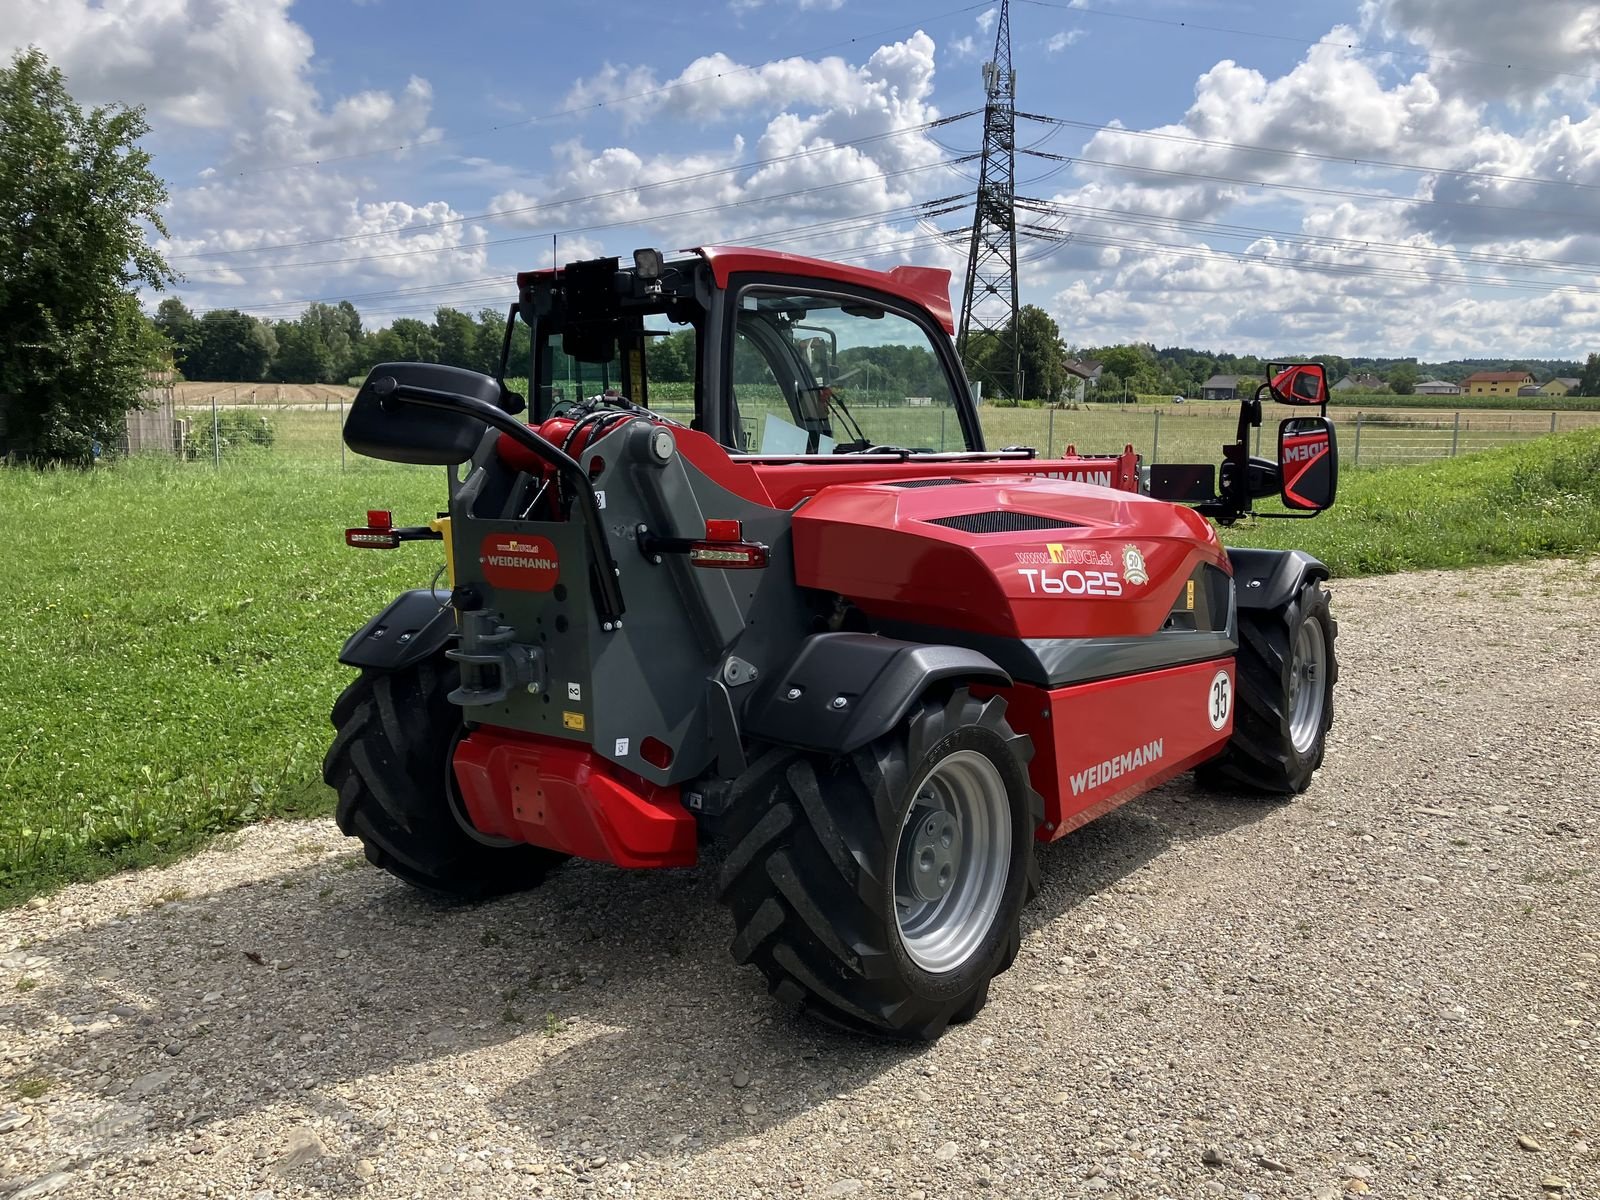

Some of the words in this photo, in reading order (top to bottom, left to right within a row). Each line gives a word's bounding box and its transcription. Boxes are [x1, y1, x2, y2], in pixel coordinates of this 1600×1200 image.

[488, 556, 551, 570] WEIDEMANN
[1015, 545, 1114, 566] www.MAUCH.at
[1128, 554, 1139, 568] 50
[1018, 569, 1123, 597] T6025
[1213, 678, 1228, 722] 35
[1069, 738, 1163, 796] WEIDEMANN
